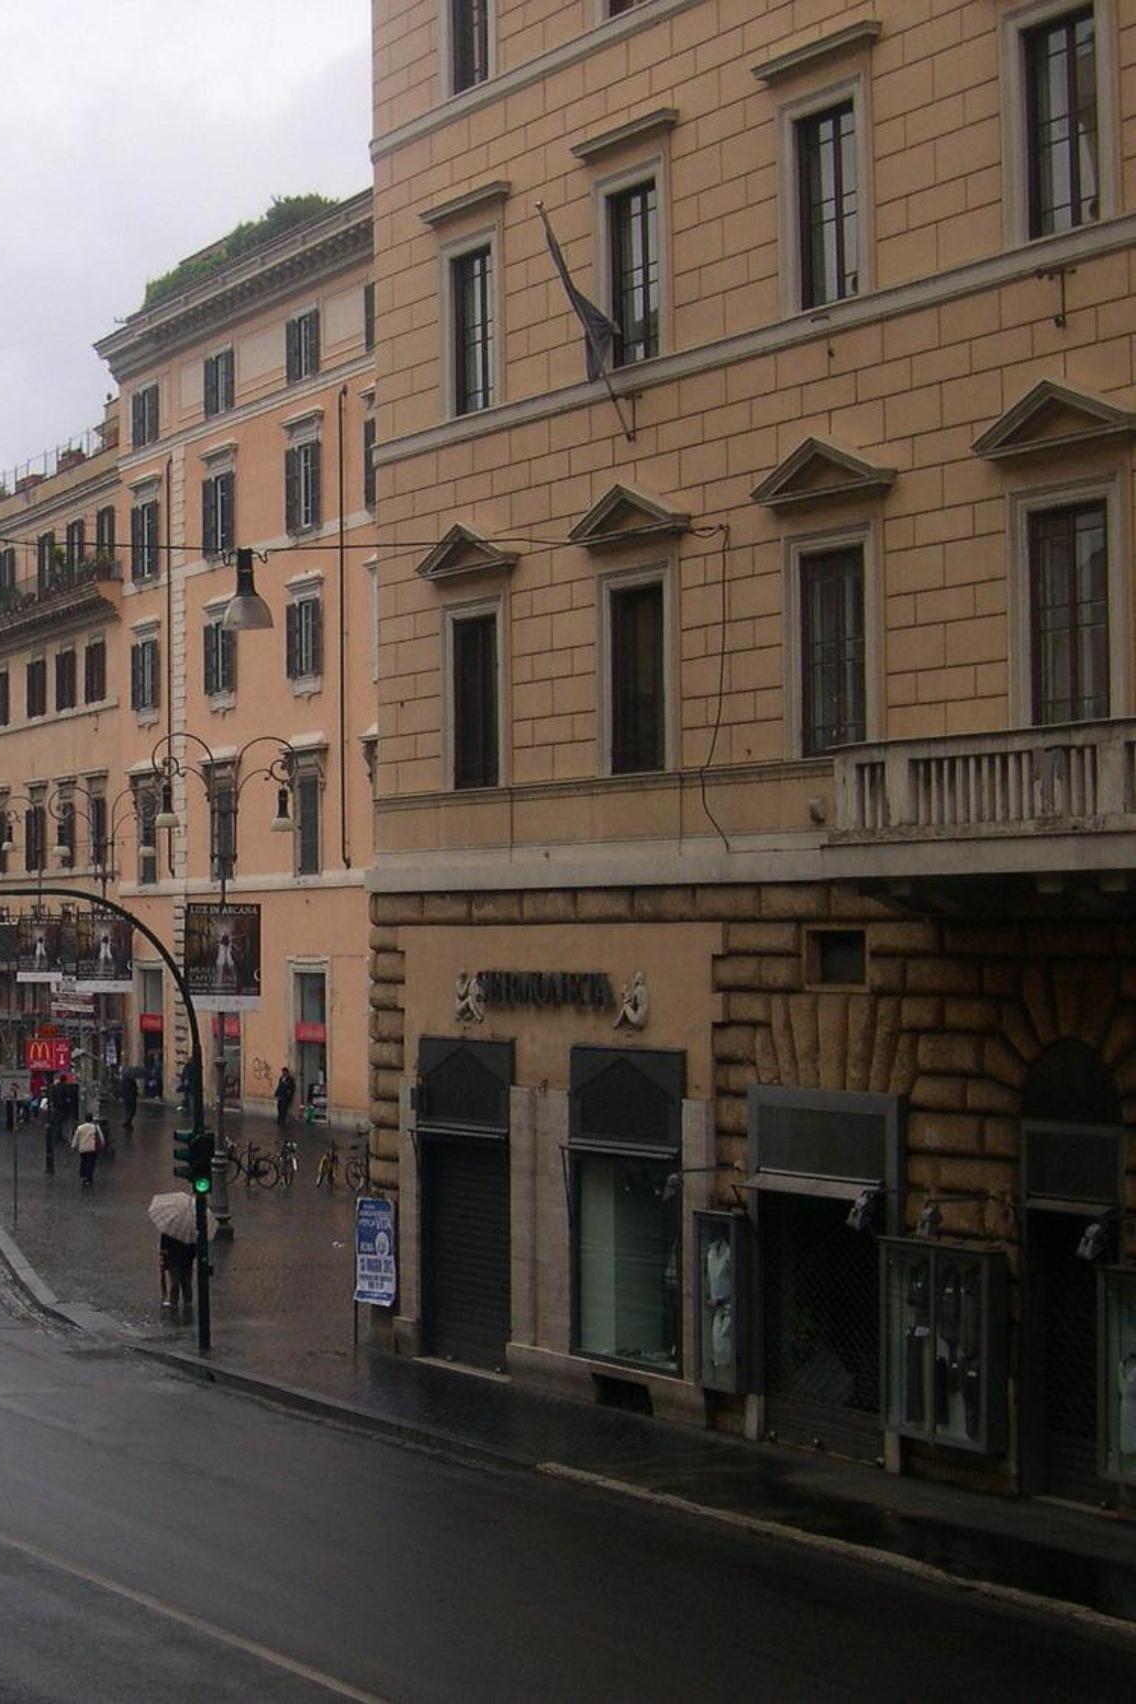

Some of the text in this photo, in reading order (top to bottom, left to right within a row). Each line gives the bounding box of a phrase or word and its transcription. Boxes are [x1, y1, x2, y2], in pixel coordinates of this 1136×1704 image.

[190, 905, 257, 915] LUX IN ARCANA
